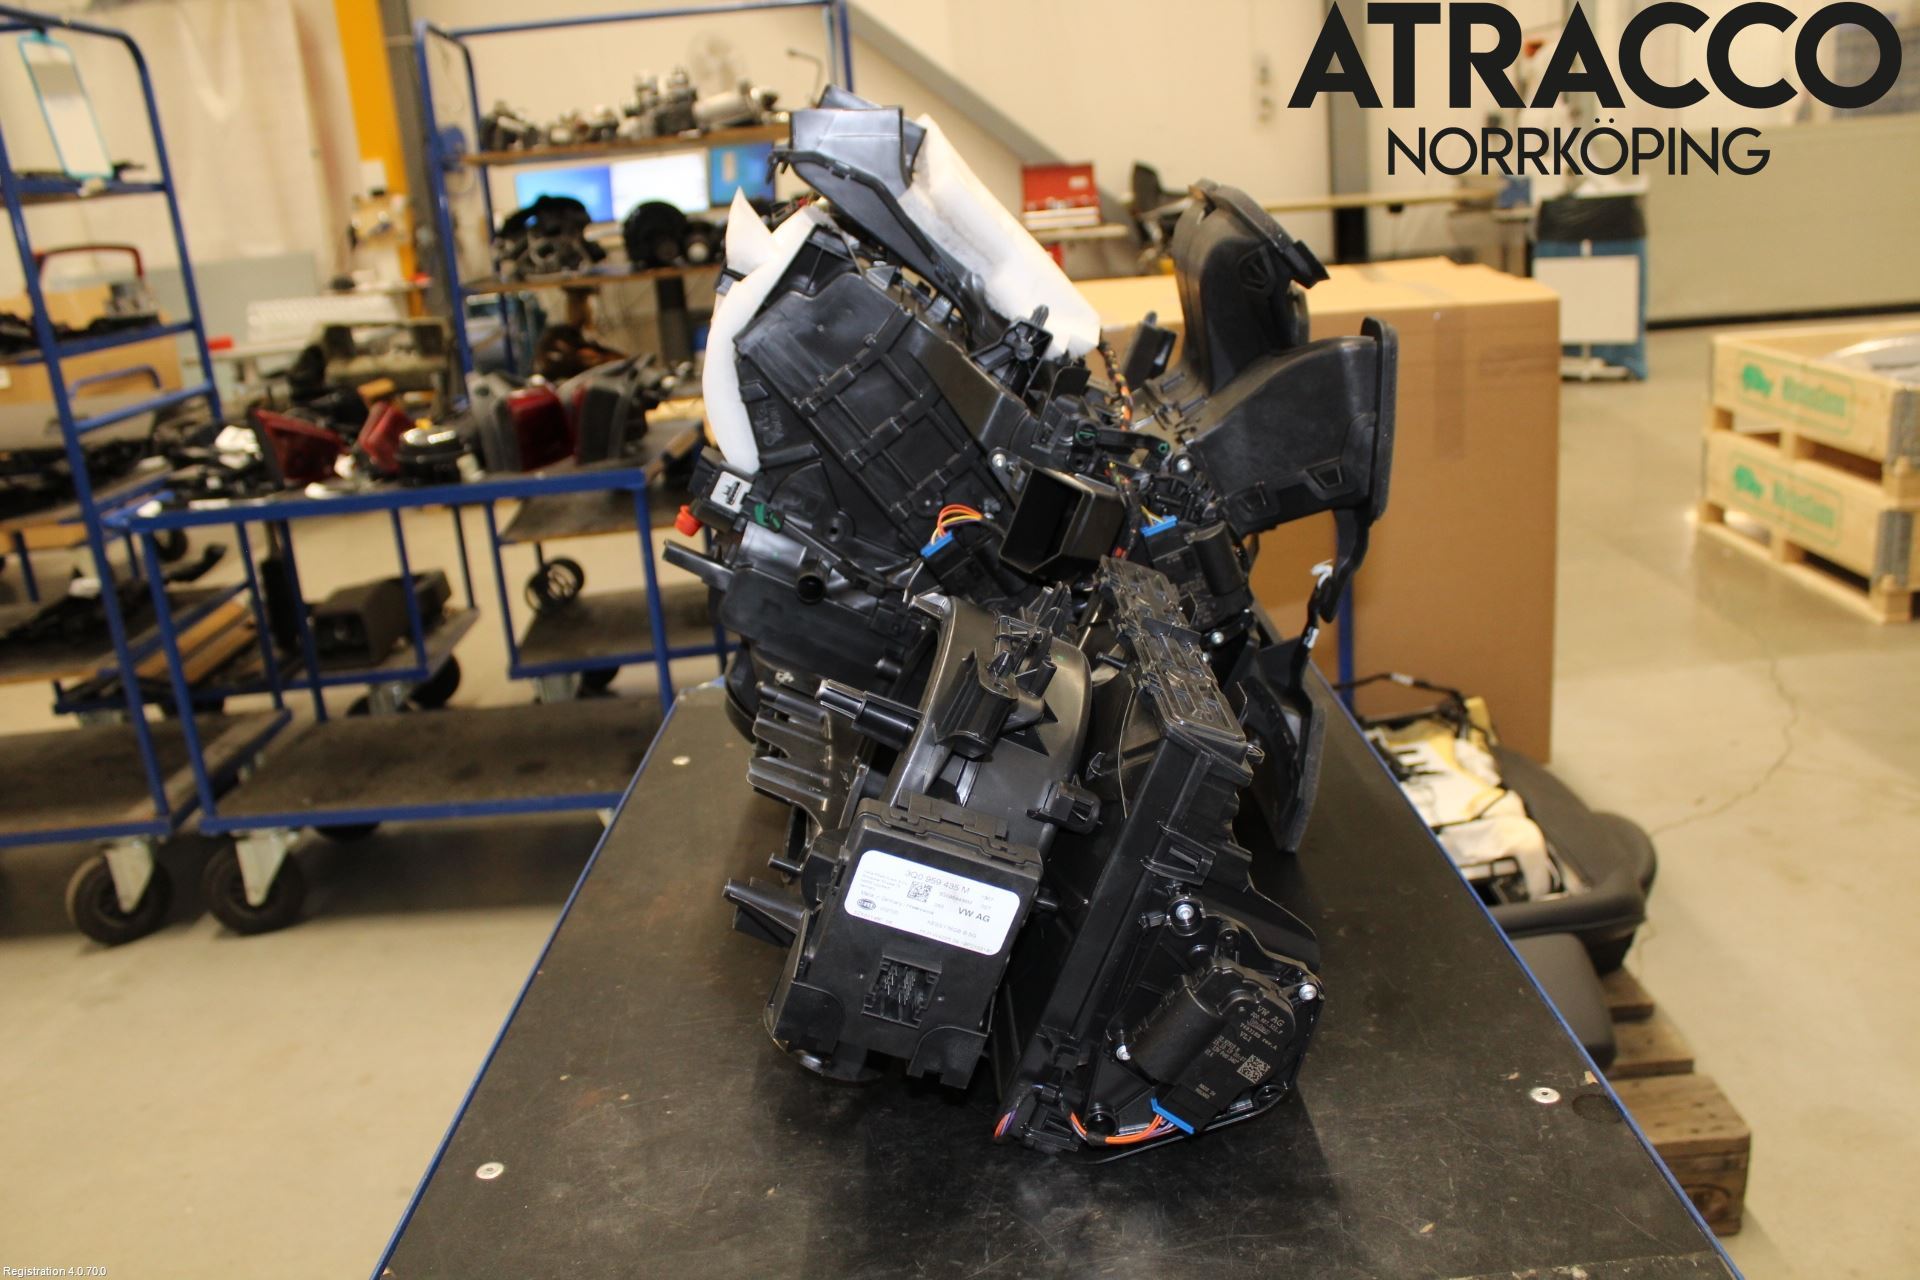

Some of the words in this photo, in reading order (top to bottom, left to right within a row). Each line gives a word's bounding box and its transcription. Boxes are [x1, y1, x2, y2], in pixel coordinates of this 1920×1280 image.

[925, 875, 942, 886] 959
[961, 886, 970, 895] M
[958, 907, 974, 918] VW
[975, 913, 991, 923] AG
[1258, 1005, 1270, 1016] VW
[1271, 1015, 1285, 1027] AG
